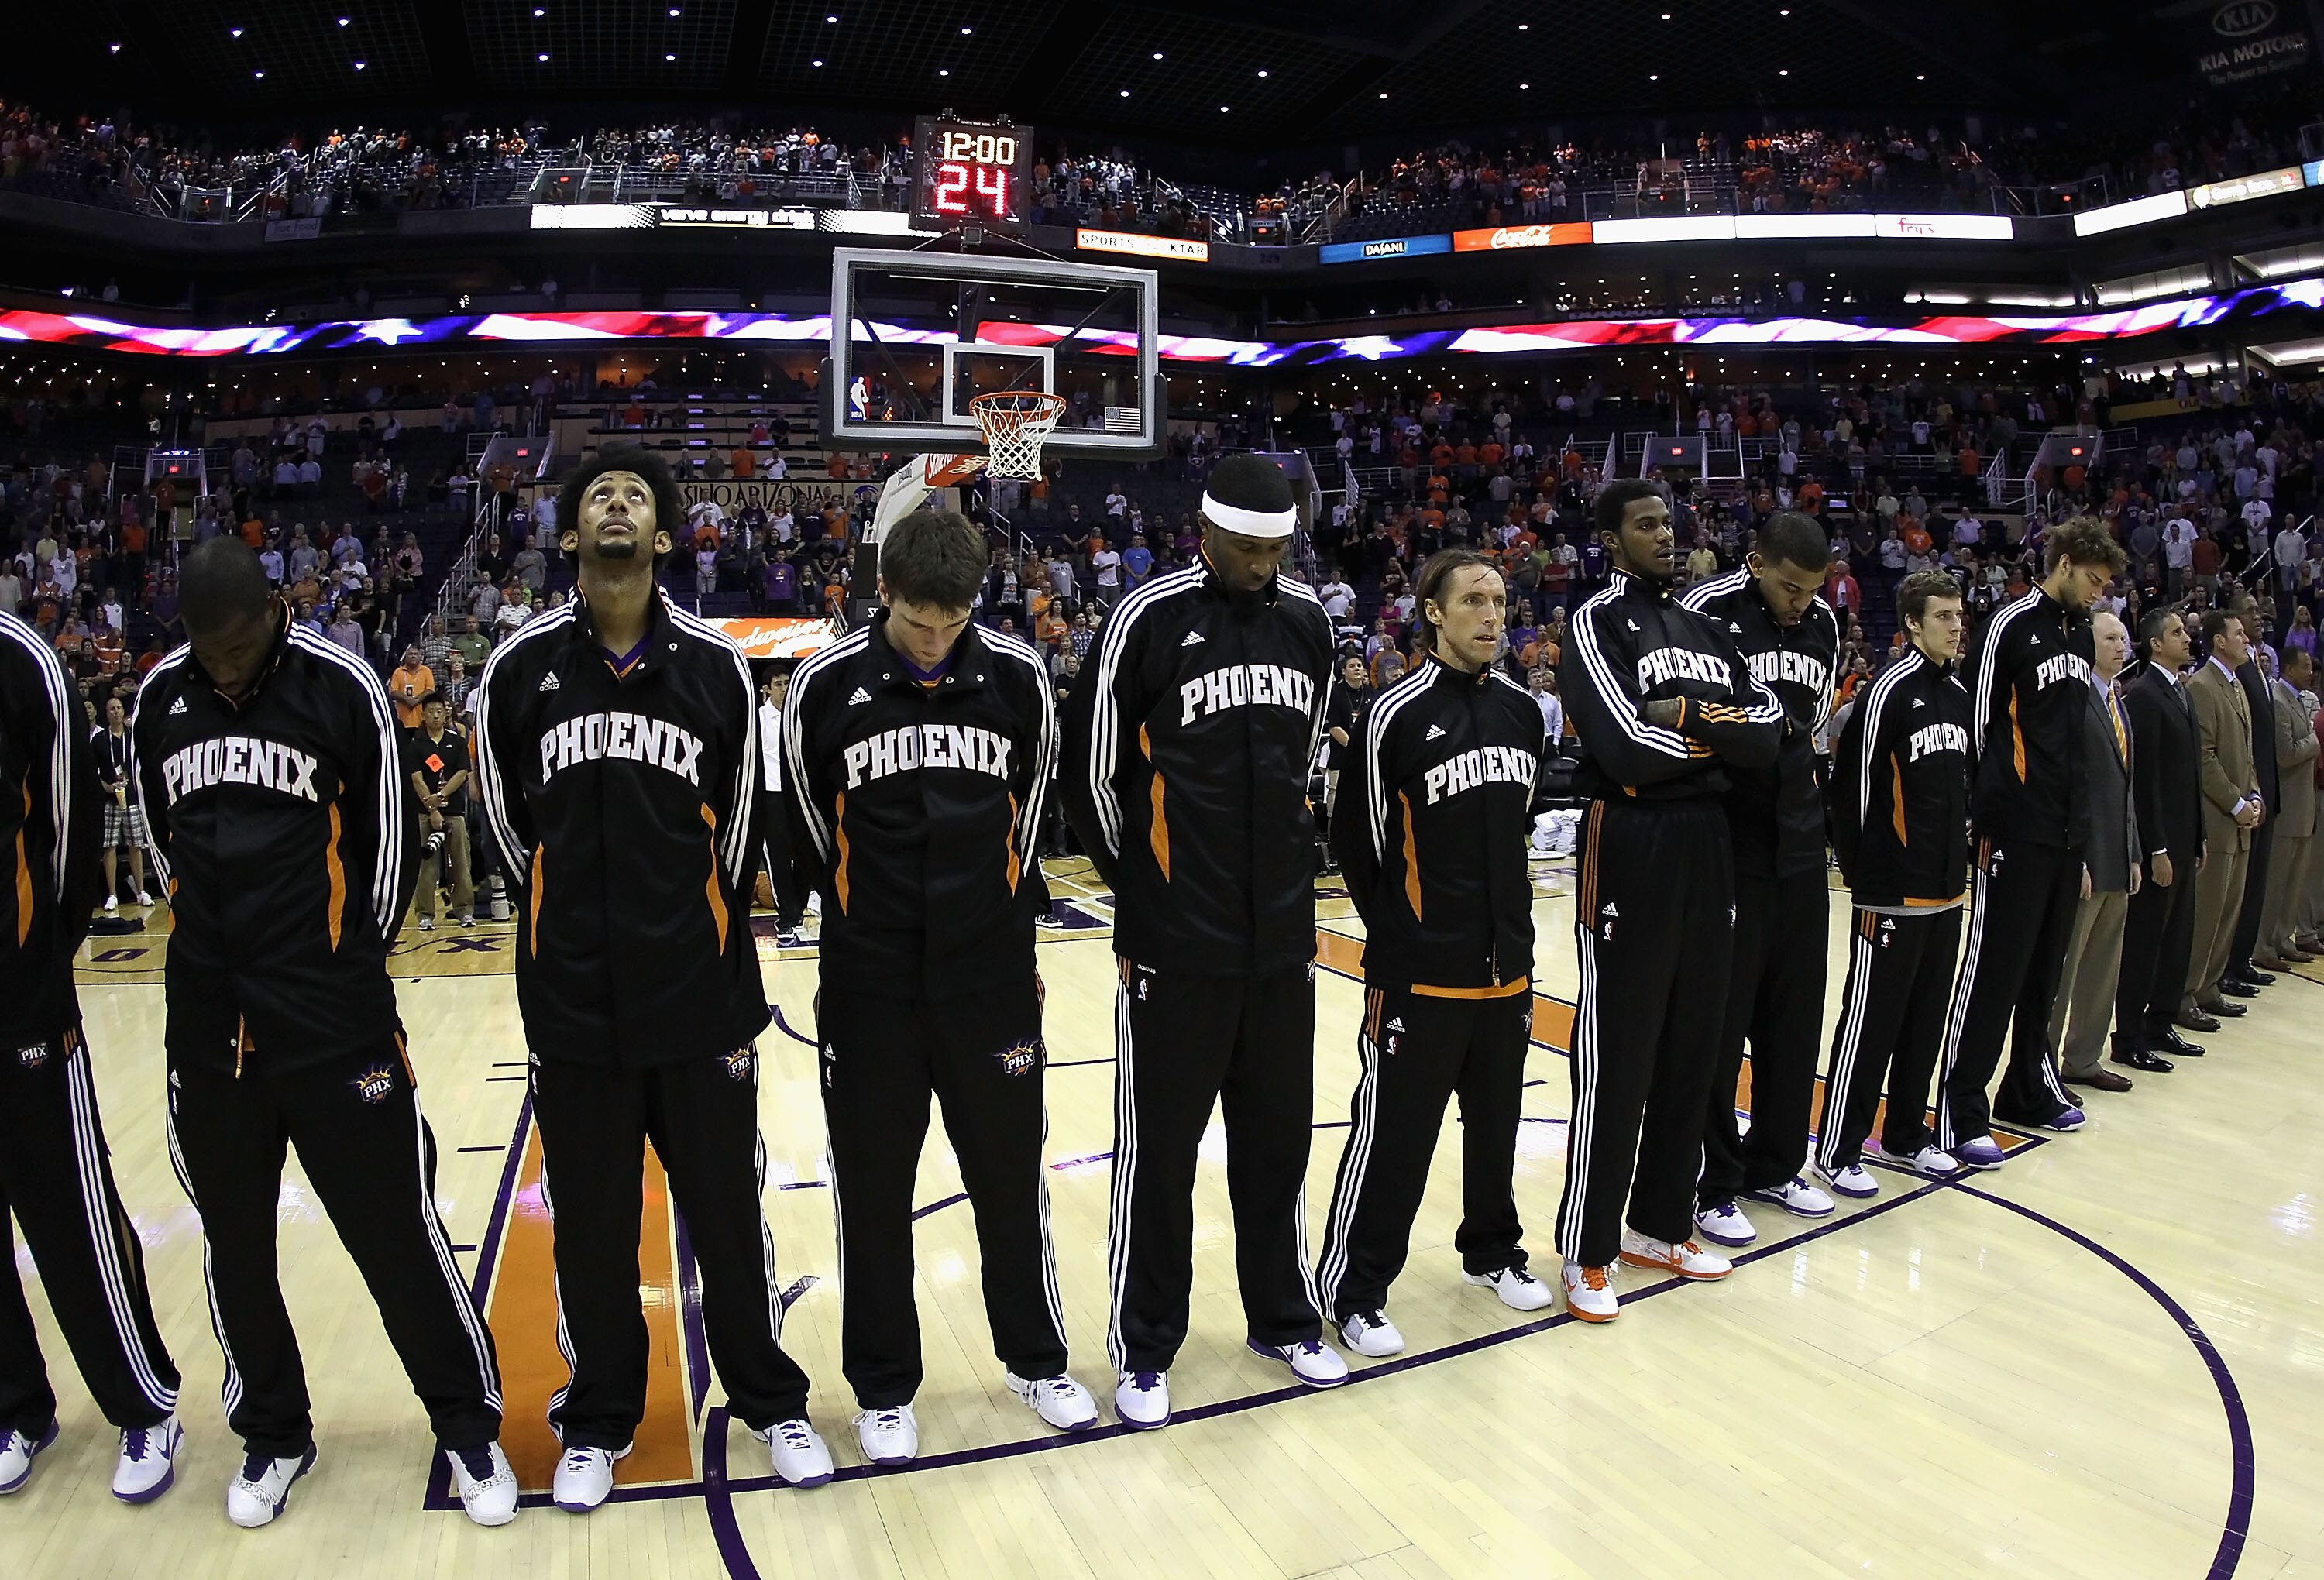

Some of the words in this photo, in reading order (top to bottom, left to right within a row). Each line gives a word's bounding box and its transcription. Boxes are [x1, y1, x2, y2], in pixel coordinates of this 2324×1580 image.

[2223, 4, 2268, 31] KIA
[2199, 50, 2230, 73] KIA
[943, 131, 1016, 166] 12:00
[937, 163, 1006, 215] 24
[1081, 233, 1135, 249] SPORTS
[1170, 243, 1205, 256] KTAR
[1365, 241, 1405, 256] DASANI
[1637, 647, 1734, 696] PHOENIX
[1746, 650, 1827, 696] HOENIX
[848, 696, 872, 706] adidas
[1180, 663, 1315, 727] PHOENIX
[1425, 730, 1446, 741] adidas
[540, 711, 703, 788] PHOENIX
[844, 724, 1012, 791] PHOENIX
[163, 737, 318, 807] PHOENIX
[1137, 963, 1157, 974] adidas
[1386, 1023, 1406, 1032] adidas
[22, 1046, 47, 1061] PHX
[731, 1056, 751, 1074] PHX
[1007, 1053, 1033, 1071] PHX
[364, 1078, 391, 1098] PHX
